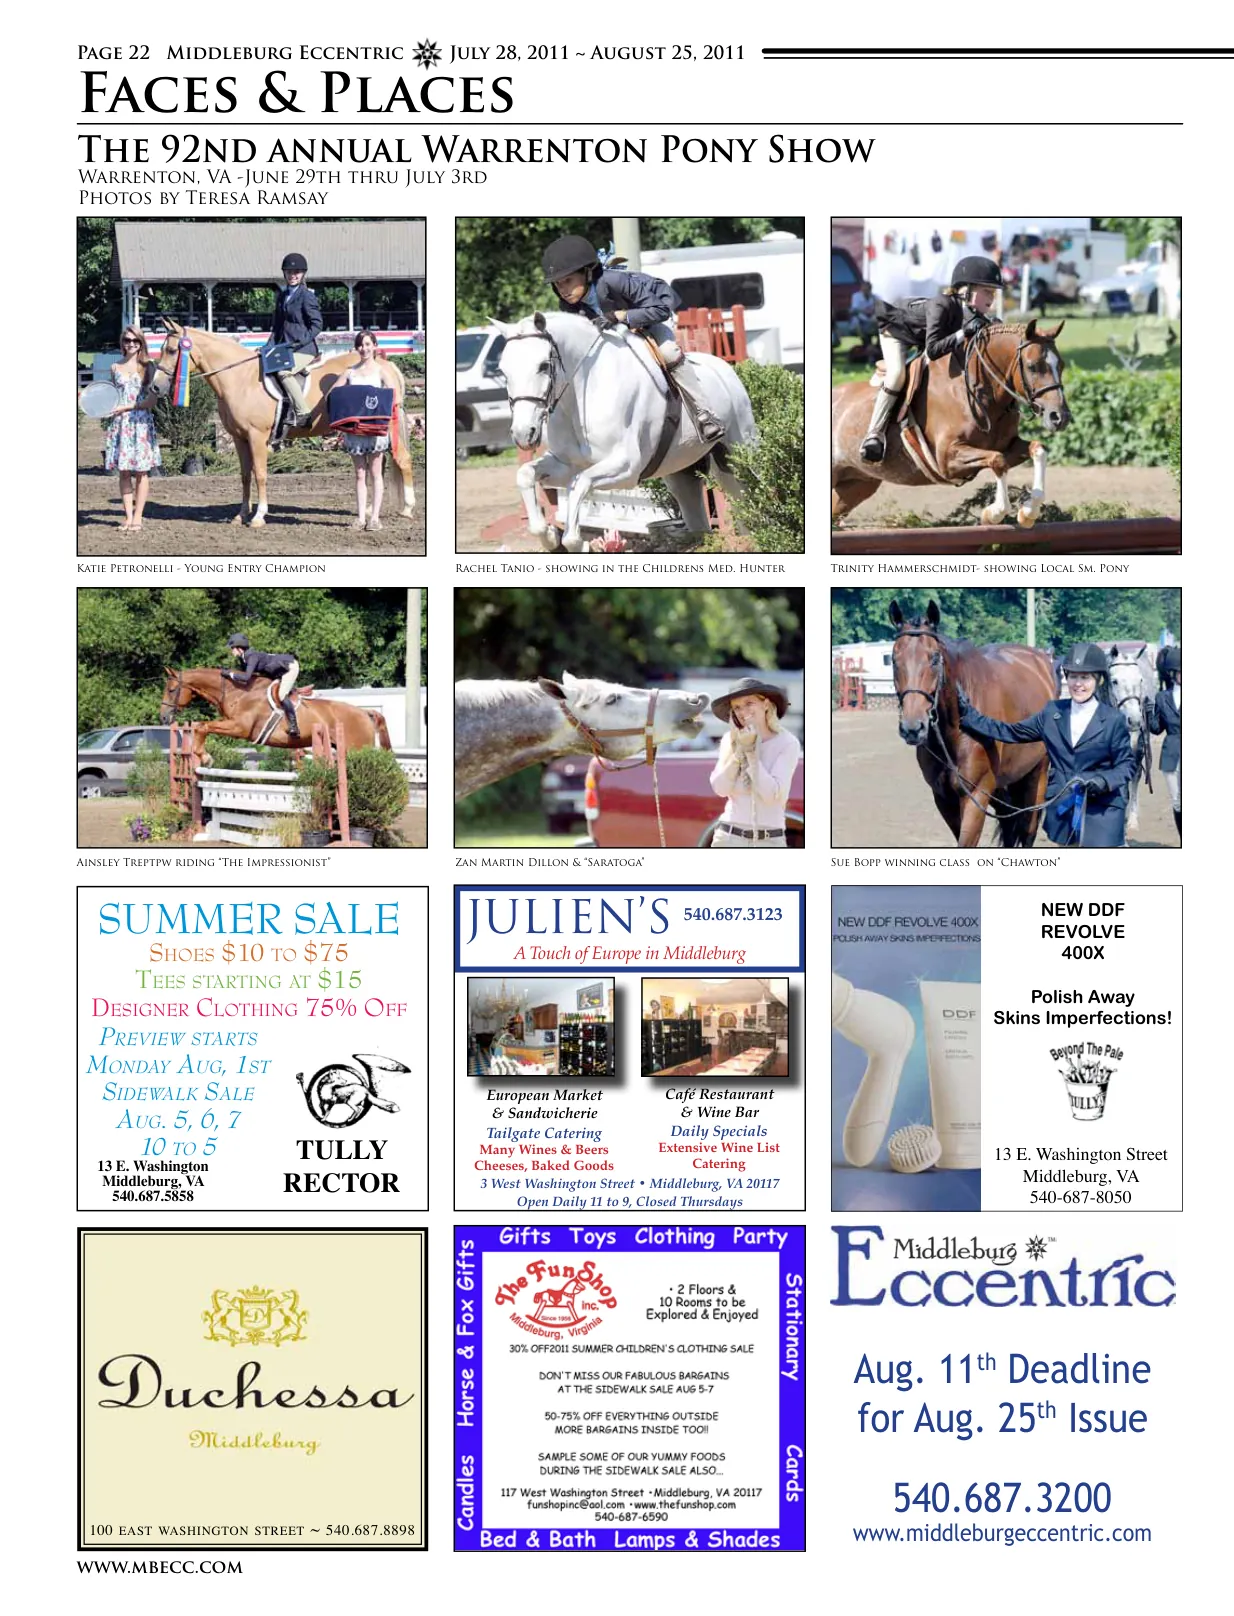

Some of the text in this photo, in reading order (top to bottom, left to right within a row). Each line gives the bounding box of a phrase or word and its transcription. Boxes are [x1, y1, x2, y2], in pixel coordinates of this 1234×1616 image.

[78, 45, 743, 64] PAGE 22 MIDDLEBURG ECCENTRIC JULY 28, 2011 AUGUST 25, 2011
[81, 71, 513, 113] FACES & PLACES
[78, 134, 876, 163] THE 92ND ANNUAL WARRENTON PONY SHOW
[78, 169, 199, 184] WARRENTON,
[207, 169, 231, 183] VA
[296, 169, 340, 183] 29TH
[348, 171, 398, 183] THRU
[406, 169, 445, 187] JULY
[452, 169, 487, 183] 3RD
[80, 190, 328, 204] PHOTOS BY TERESA RAMSAY
[77, 563, 326, 573] KATIE PETRONELLI YOUNG ENTRY CHAMPION
[830, 563, 875, 573] TRINITY
[983, 564, 1037, 573] SHOWING
[1041, 563, 1075, 573] LOCAL
[1078, 563, 1096, 573] SM.
[1100, 563, 1130, 573] PONY
[100, 902, 398, 935] SUMMER SALE
[684, 908, 782, 920] 540.687.3123
[1042, 903, 1125, 916] NEW DDF
[467, 896, 668, 944] JULIEN'S
[1042, 925, 1125, 938] REVOLVE
[150, 940, 348, 964] SHOES $10 TO $75
[1062, 946, 1104, 959] 400X
[1032, 990, 1135, 1007] Polish Away
[942, 1009, 977, 1019] DDF
[994, 1011, 1171, 1026] Skins Imperfections!
[296, 1140, 388, 1160] TULLY
[98, 1160, 208, 1174] 13 E. Washington
[103, 1175, 204, 1189] Middleburg, VA
[283, 1173, 400, 1193] RECTOR
[112, 1190, 194, 1201] 540.687.5858
[1030, 1191, 1131, 1203] 540-687-8050
[500, 1227, 788, 1249] Gifts Toys Clothing Party
[894, 1236, 1017, 1266] Middleburg
[830, 1225, 1176, 1307] Eccentric
[782, 1272, 803, 1381] Stationary
[98, 1354, 414, 1409] Duchessa
[854, 1353, 923, 1392] Aug.
[1010, 1353, 1150, 1384] Deadline
[189, 1430, 319, 1455] Middleburg
[785, 1444, 803, 1503] Cards
[895, 1482, 1111, 1513] 540.687.3200
[594, 1511, 669, 1522] 540-687-6590
[481, 1530, 780, 1549] Bed & Bath Lamps & Shades
[853, 1523, 1151, 1546] www.middleburgeccentric.com
[77, 1561, 243, 1573] WWW.MBECC.COM
